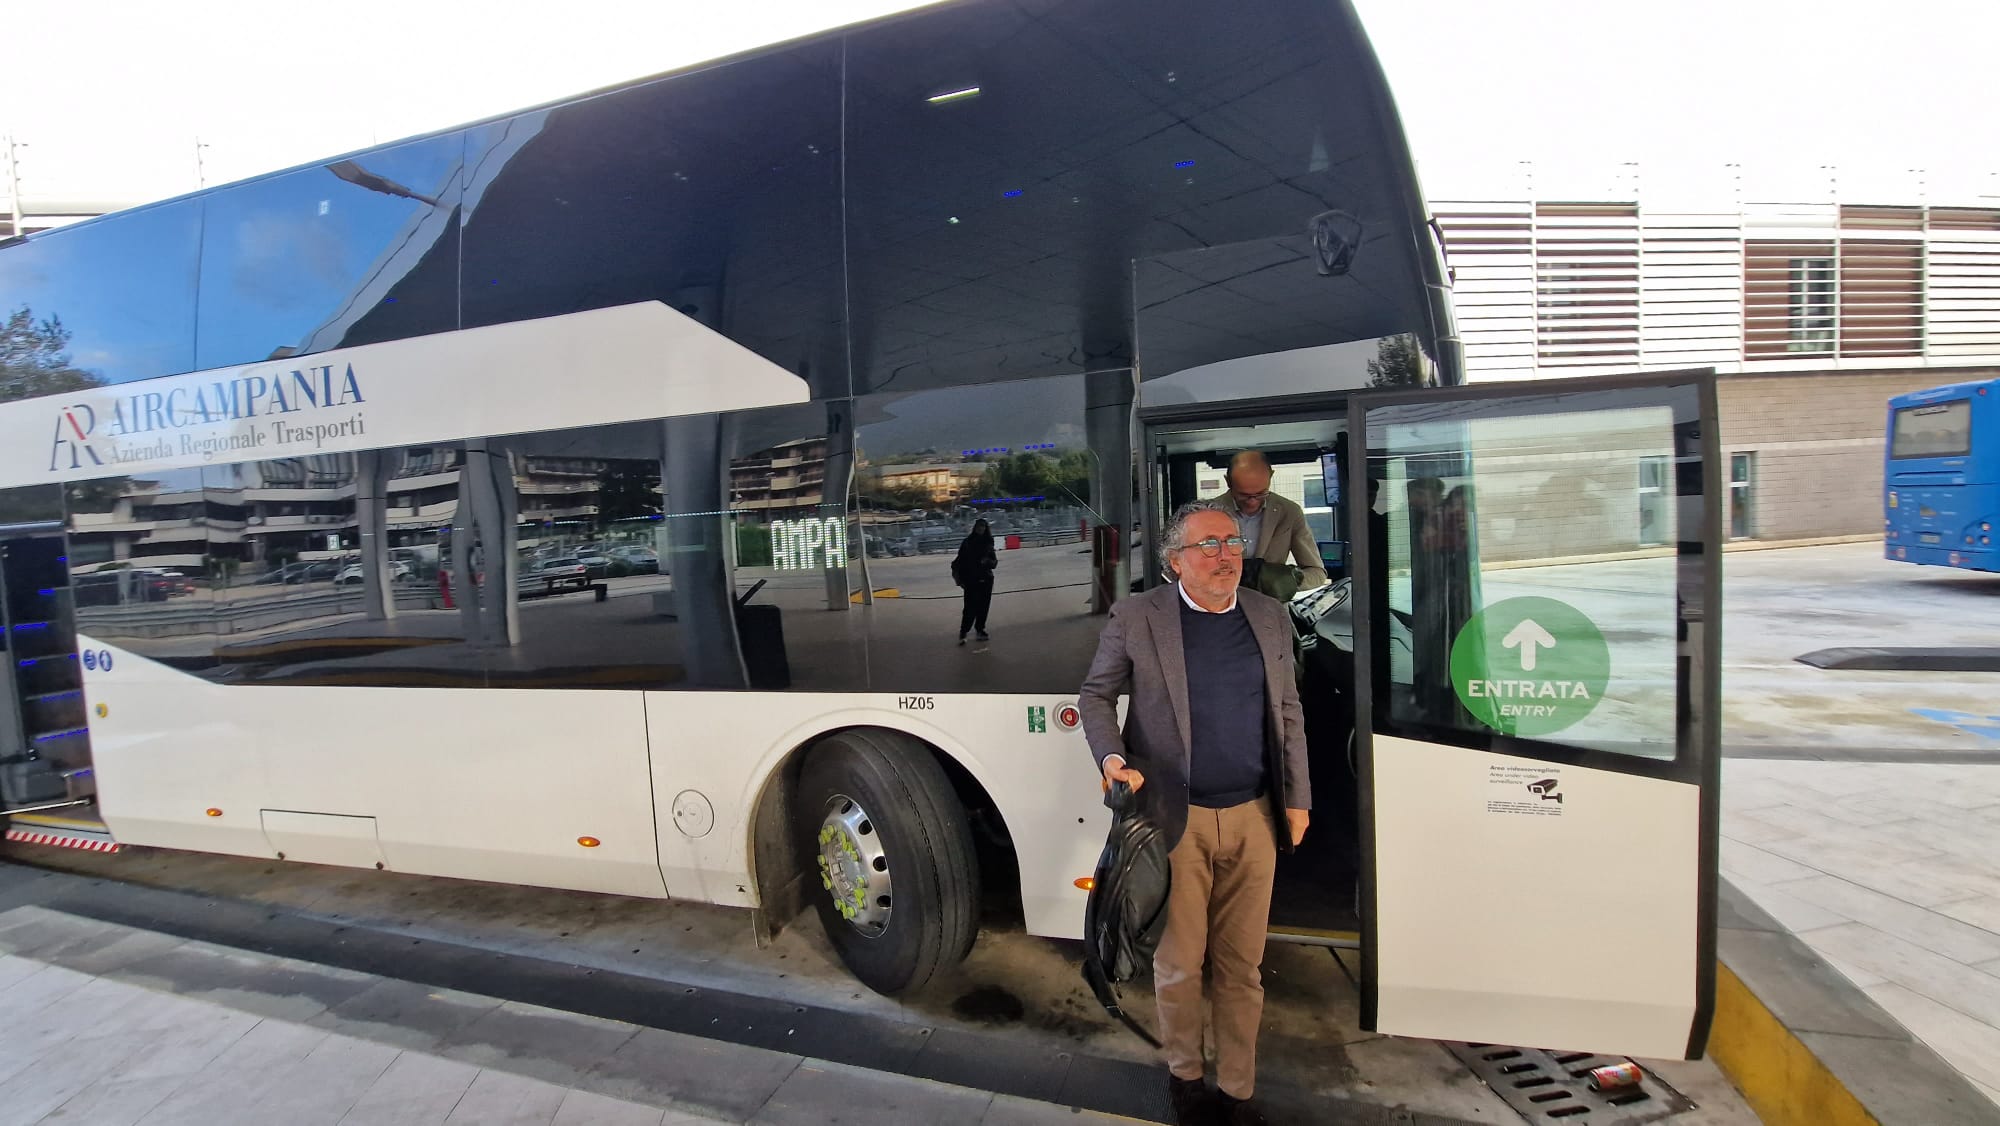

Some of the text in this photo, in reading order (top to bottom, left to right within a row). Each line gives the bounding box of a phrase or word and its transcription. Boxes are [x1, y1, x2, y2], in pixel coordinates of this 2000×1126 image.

[107, 361, 366, 437] AIRCAMPANIA
[109, 413, 366, 465] Azienda Regionale Trasporti
[771, 516, 847, 570] AMPA
[899, 697, 935, 710] HZ05
[1468, 679, 1590, 699] ENTRATA
[1501, 704, 1556, 717] ENTRY
